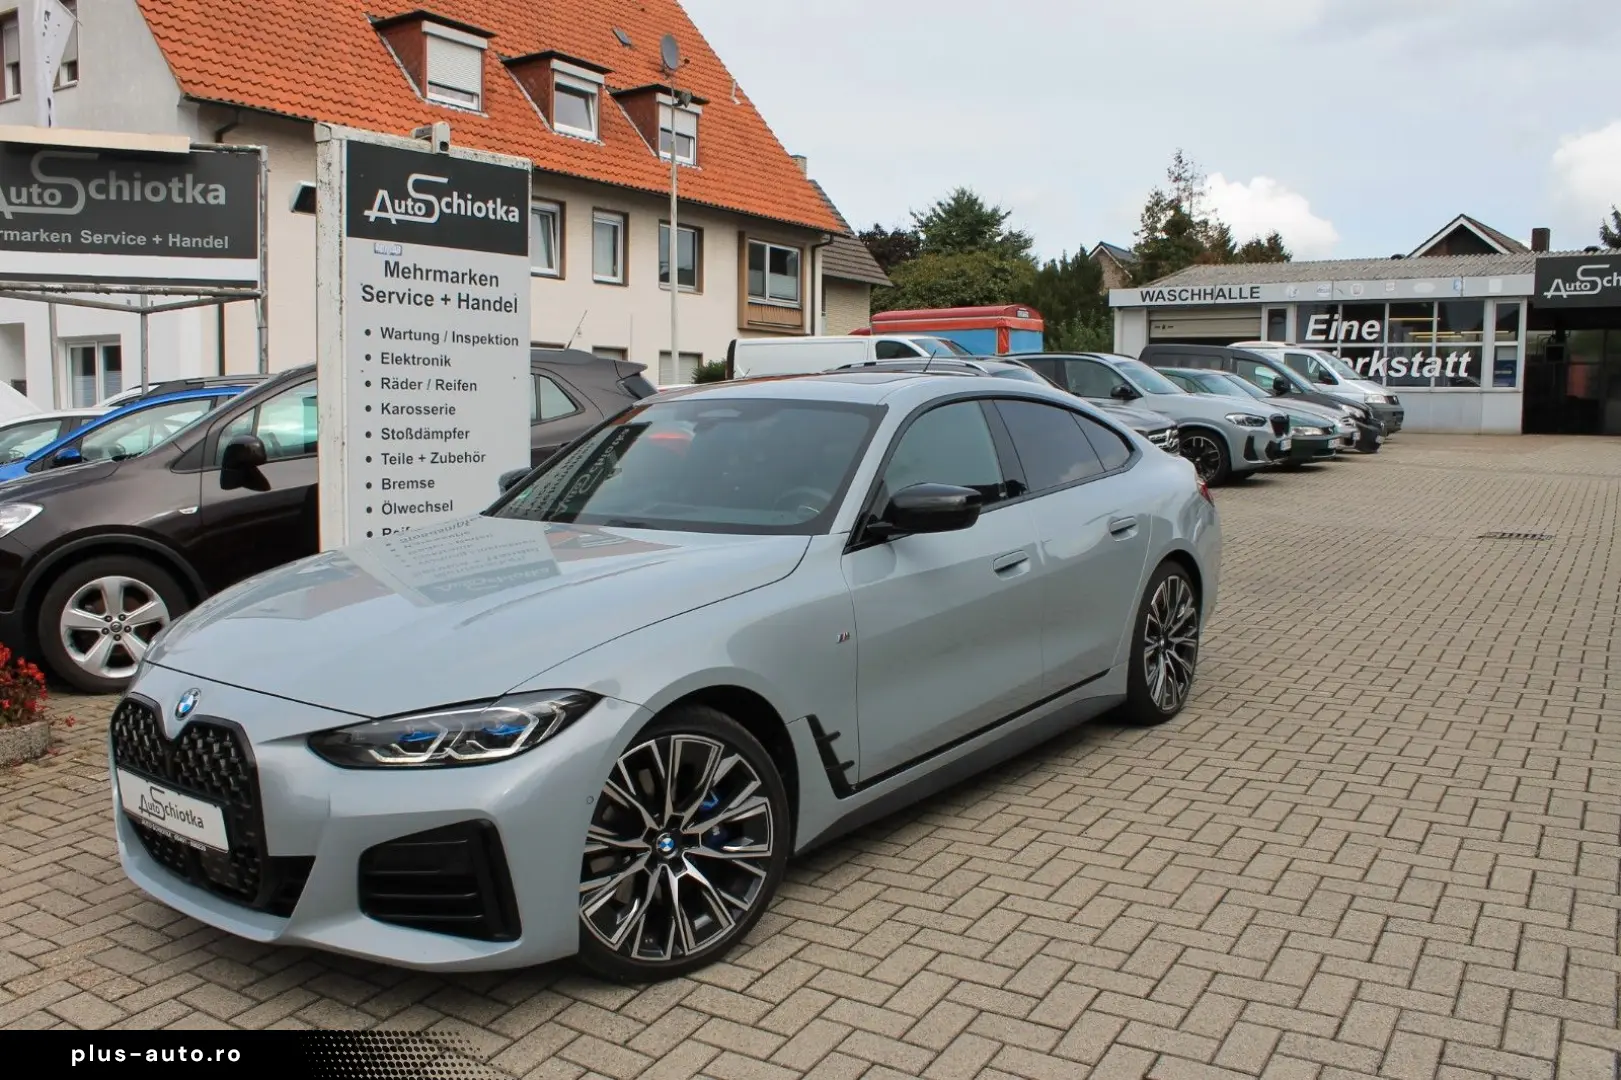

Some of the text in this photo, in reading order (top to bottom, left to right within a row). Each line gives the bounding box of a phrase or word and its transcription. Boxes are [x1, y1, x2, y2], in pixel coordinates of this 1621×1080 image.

[30, 151, 226, 215] Schiotka
[364, 173, 520, 224] Auto Schiotka
[80, 229, 147, 246] Service
[152, 234, 163, 245] +
[168, 233, 229, 249] Handel
[384, 260, 499, 287] Mehrmarken
[1140, 286, 1261, 303] WASCHHALLE
[1543, 278, 1591, 298] Auto
[361, 284, 518, 313] Service + Handel
[380, 326, 519, 347] Wartung / Inspektion
[1305, 313, 1381, 341] Eine
[380, 352, 452, 367] Elektronik
[381, 377, 478, 392] Räder / Reifen
[381, 402, 456, 416] Karosserie
[381, 427, 470, 442] Stoßdämpfer
[381, 451, 486, 465] Teile + Zubehör
[382, 478, 435, 490] Bremse
[381, 500, 453, 515] Ölwechsel
[150, 786, 204, 829] Schiotka
